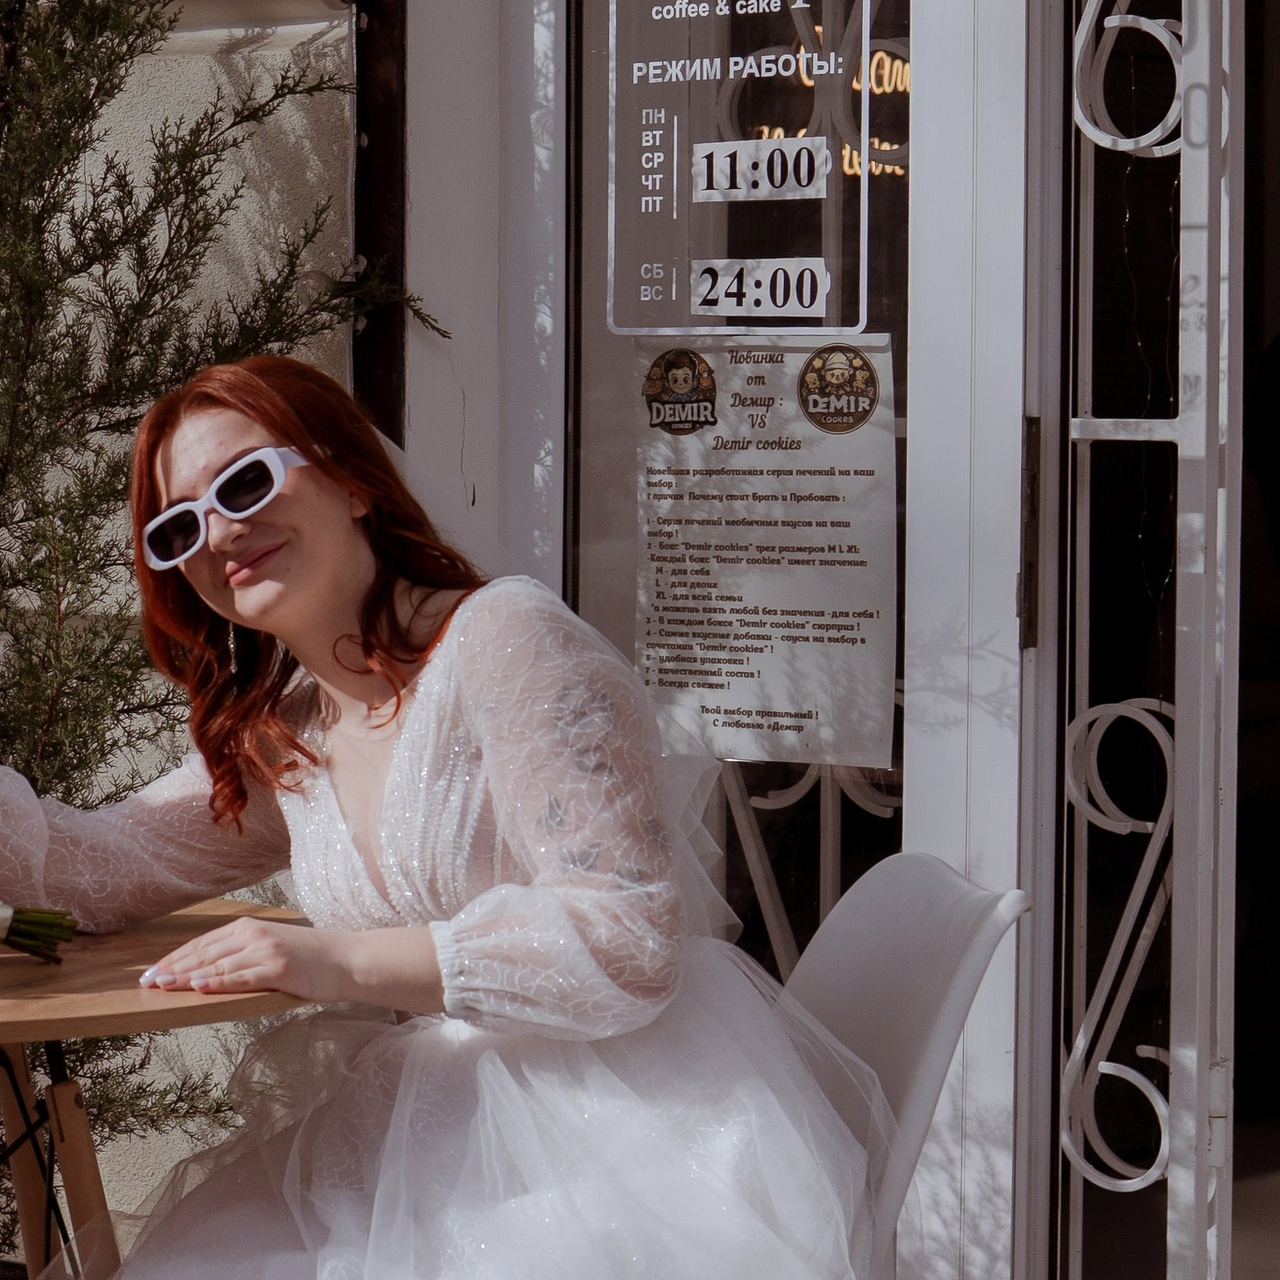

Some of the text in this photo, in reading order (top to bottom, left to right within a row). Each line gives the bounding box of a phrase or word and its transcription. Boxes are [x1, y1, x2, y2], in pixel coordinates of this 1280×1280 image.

[652, 0, 710, 20] coffee
[632, 57, 722, 84] РЕЖИМ
[728, 51, 844, 79] РАБОТЫ:
[641, 108, 666, 125] ПН
[641, 130, 663, 147] ВТ
[641, 152, 665, 169] СР
[700, 146, 816, 191] 11:00
[641, 174, 663, 191] ЧТ
[641, 196, 663, 213] ПТ
[640, 263, 664, 280] СБ
[640, 285, 663, 302] ВС
[698, 266, 818, 309] 24:00
[728, 349, 785, 365] Новинка
[746, 373, 766, 386] от
[730, 393, 777, 414] Демир
[651, 402, 715, 425] DEMIR
[748, 413, 767, 429] VS
[713, 435, 802, 451] Demir cookies
[646, 466, 690, 476] Новейшая
[693, 467, 764, 478] разработанная
[766, 469, 793, 478] серия
[796, 467, 836, 477] печений
[646, 480, 673, 489] выбор
[653, 493, 684, 502] причин
[688, 492, 723, 502] Почему
[725, 493, 750, 501] стоит
[752, 492, 779, 503] Брать
[790, 492, 840, 503] Пробовать
[657, 516, 682, 526] Серия
[684, 517, 722, 526] печений
[724, 518, 778, 527] необычных
[781, 520, 813, 529] вкусов
[646, 530, 673, 539] выбор
[658, 542, 680, 551] Бокс
[755, 545, 776, 554] трех
[778, 546, 826, 555] размеров
[688, 554, 710, 564] бокс
[787, 558, 816, 567] имеет
[670, 568, 687, 576] для
[689, 567, 710, 576] себя
[655, 579, 718, 589] L для двоих
[655, 591, 667, 600] XL
[691, 592, 713, 602] всей
[715, 594, 743, 602] семьи
[662, 604, 700, 613] можешь
[702, 605, 727, 615] взять
[729, 606, 760, 616] любой
[761, 606, 778, 616] без
[780, 608, 825, 617] значения
[852, 609, 874, 619] себя
[658, 616, 665, 625] В
[666, 618, 705, 627] каждом
[706, 617, 734, 627] боксе
[811, 622, 855, 632] сюрприз
[646, 629, 651, 637] 4
[658, 629, 690, 638] Самые
[691, 631, 731, 640] вкусные
[732, 632, 772, 641] добавки
[780, 634, 810, 644] соусы
[812, 635, 825, 643] на
[827, 635, 858, 646] выбор
[646, 642, 694, 651] сочетании
[658, 654, 698, 664] удобная
[700, 656, 744, 666] упаковка
[657, 667, 723, 677] качественный
[725, 670, 755, 679] состав
[657, 678, 725, 690] Всегда свежее
[700, 705, 813, 720] Твой выбор правильный
[712, 718, 719, 727] С
[721, 720, 764, 730] любовью
